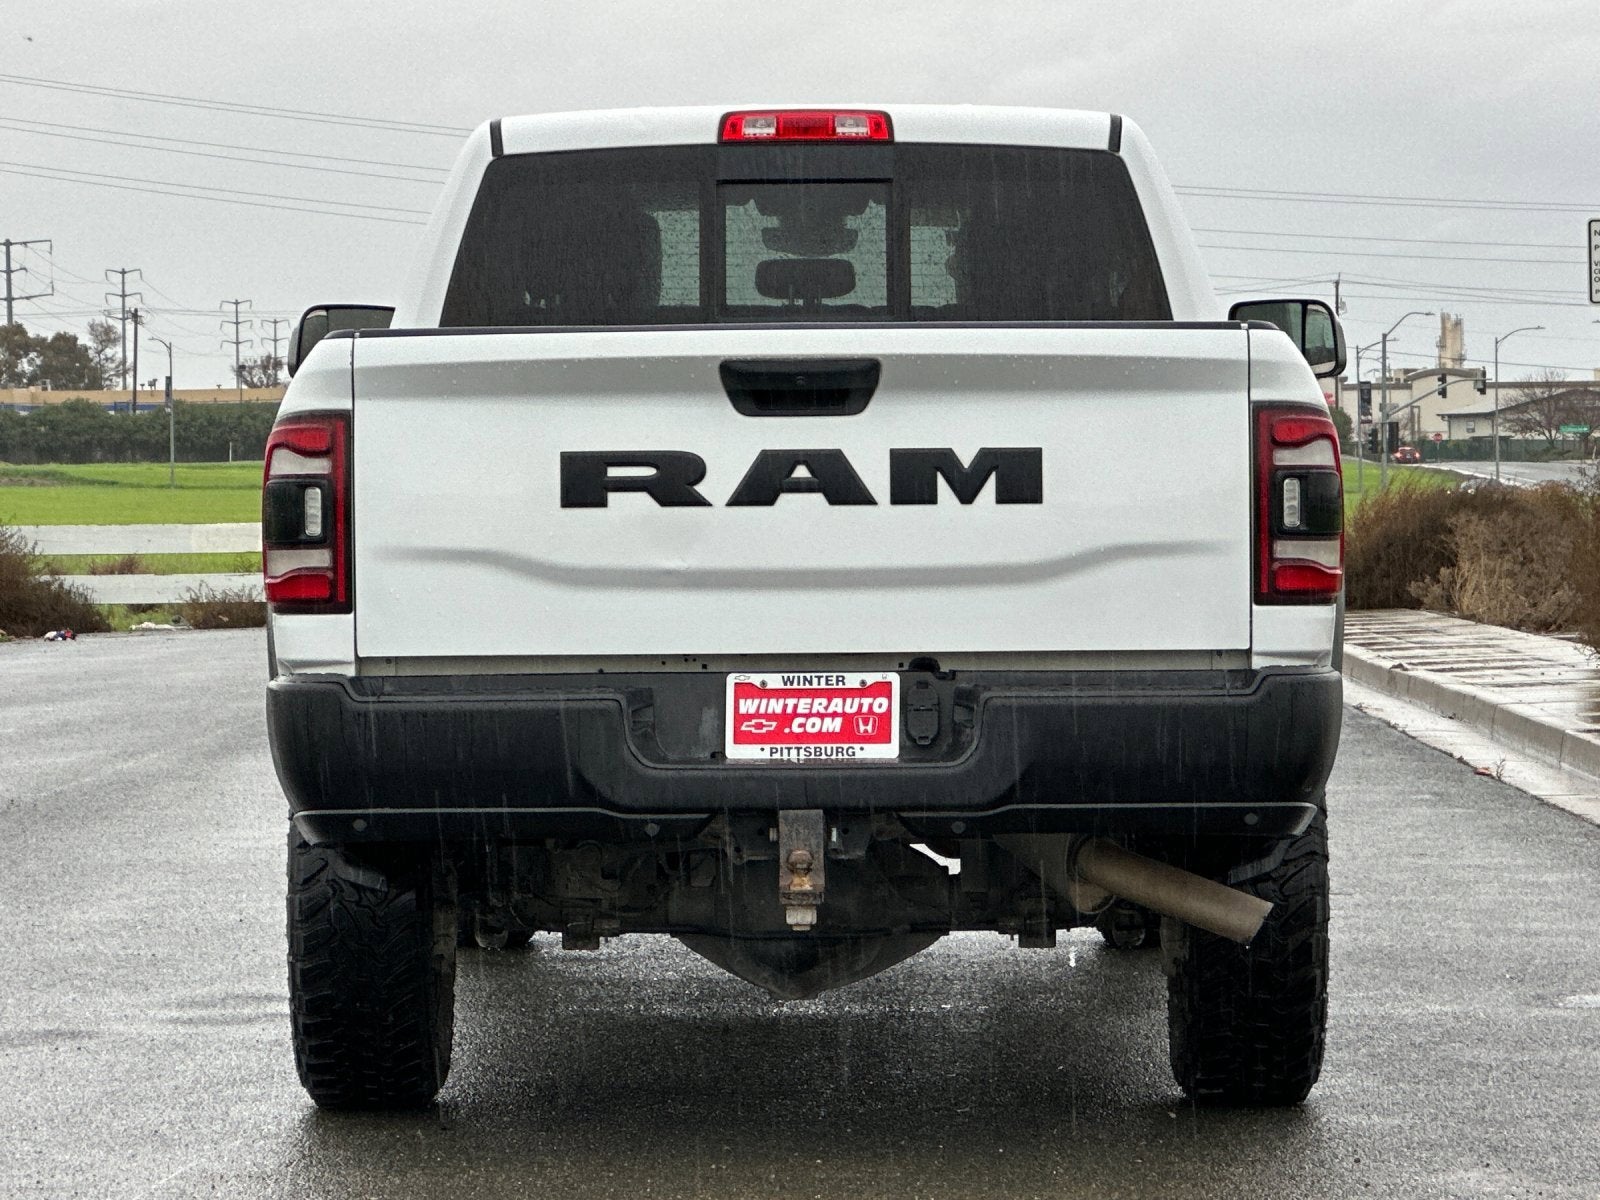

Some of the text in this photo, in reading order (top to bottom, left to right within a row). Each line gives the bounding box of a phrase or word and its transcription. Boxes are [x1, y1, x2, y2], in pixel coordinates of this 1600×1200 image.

[560, 446, 1043, 508] RAM
[781, 675, 846, 687] WINTER
[738, 697, 889, 715] WINTERAUTO
[783, 716, 843, 734] .COM
[769, 746, 856, 758] PITTSBURG
